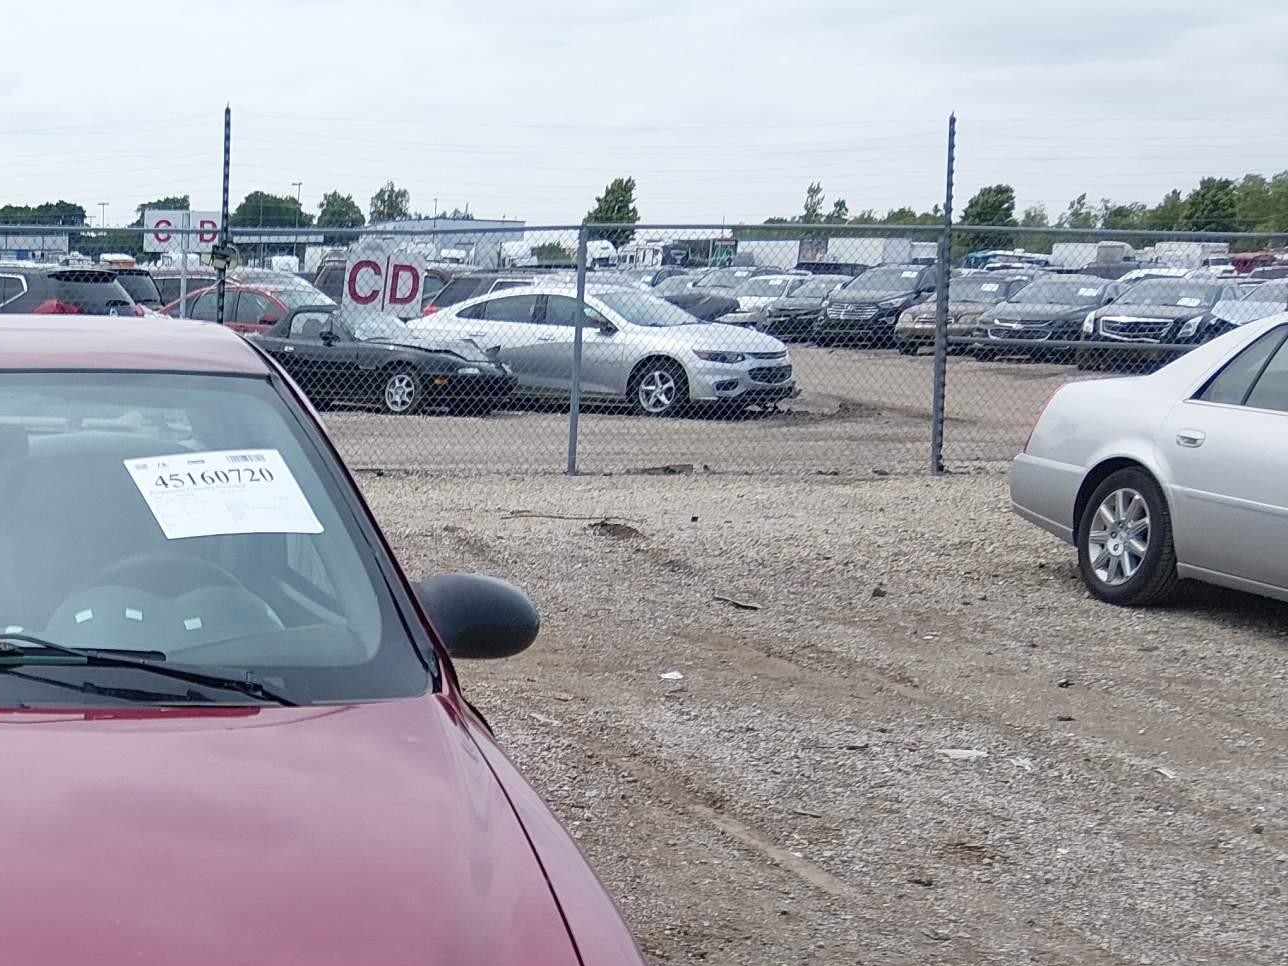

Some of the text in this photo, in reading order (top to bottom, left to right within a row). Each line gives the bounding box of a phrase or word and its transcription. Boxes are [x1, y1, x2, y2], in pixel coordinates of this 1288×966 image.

[153, 219, 218, 243] C D
[154, 467, 275, 489] 45160720
